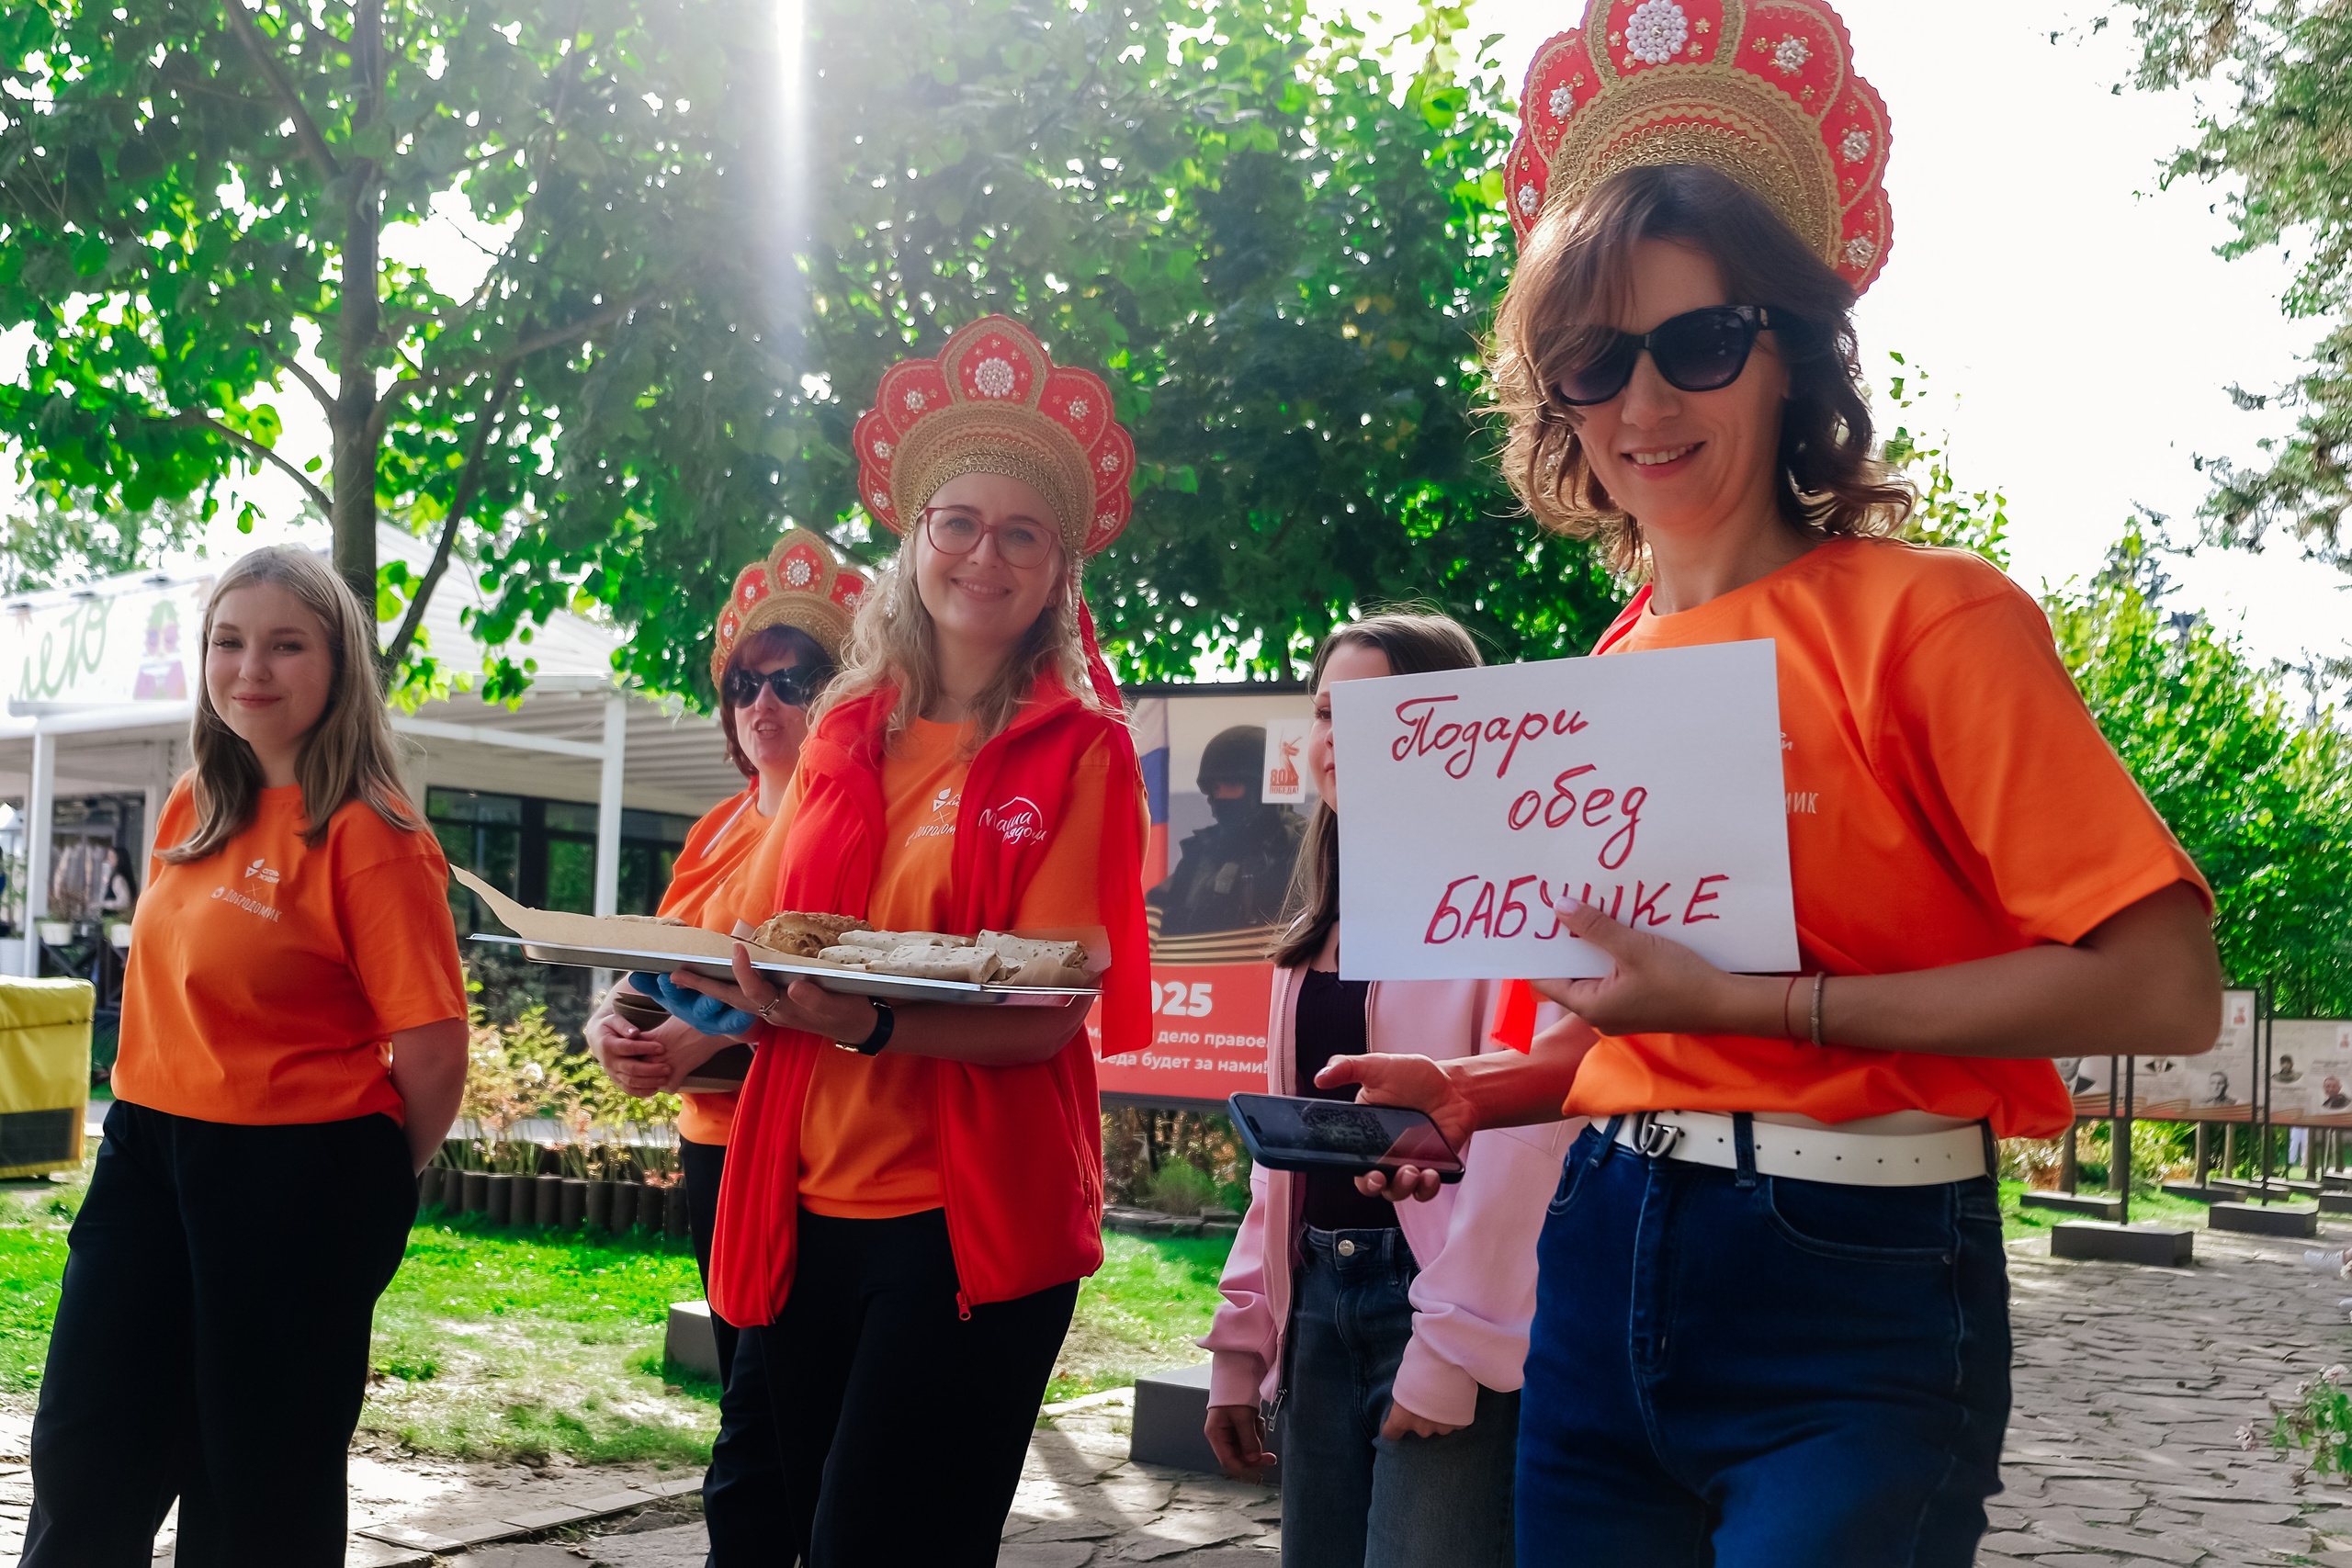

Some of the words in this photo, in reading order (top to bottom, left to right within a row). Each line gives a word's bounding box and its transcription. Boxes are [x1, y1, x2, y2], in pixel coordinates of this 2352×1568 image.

[1392, 695, 1589, 779] Подари
[1269, 785, 1299, 795] ПОБЕДА!
[978, 808, 1033, 832] Маша
[1508, 763, 1647, 870] обед
[222, 888, 282, 923] ДОБРОДОМИК
[1151, 981, 1213, 1018] 25
[1158, 1031, 1200, 1044] дело
[1142, 1053, 1191, 1070] будет
[1194, 1058, 1213, 1070] за
[1217, 1060, 1268, 1074] нами!
